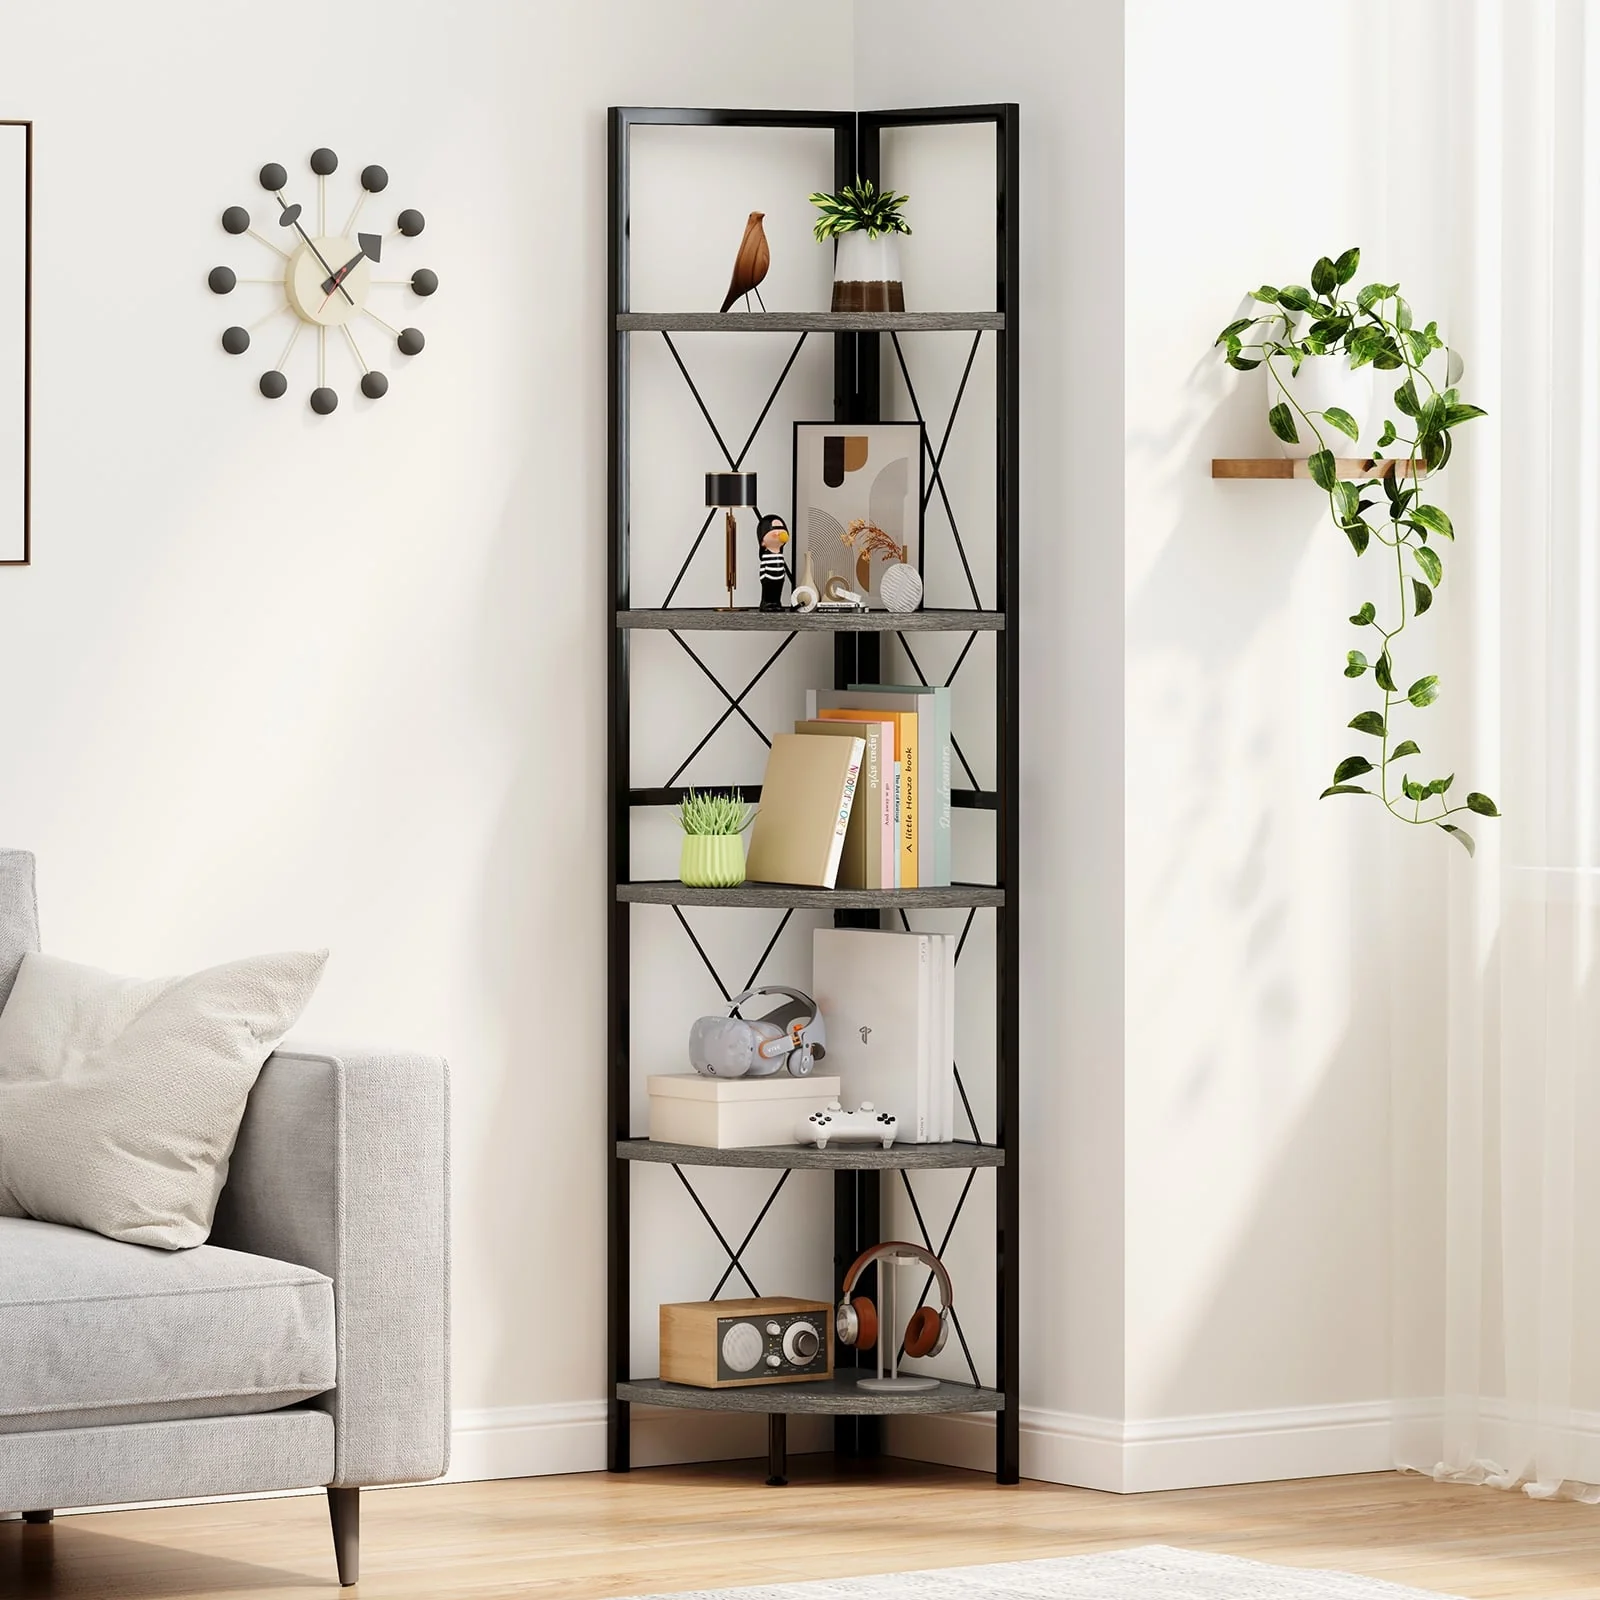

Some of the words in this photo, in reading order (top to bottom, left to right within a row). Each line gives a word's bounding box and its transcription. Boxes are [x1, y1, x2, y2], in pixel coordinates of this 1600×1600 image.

[869, 734, 879, 763] Japan
[905, 747, 913, 772] book
[868, 765, 880, 789] style
[905, 776, 913, 810] Honzo
[905, 813, 913, 840] little
[906, 844, 913, 853] A
